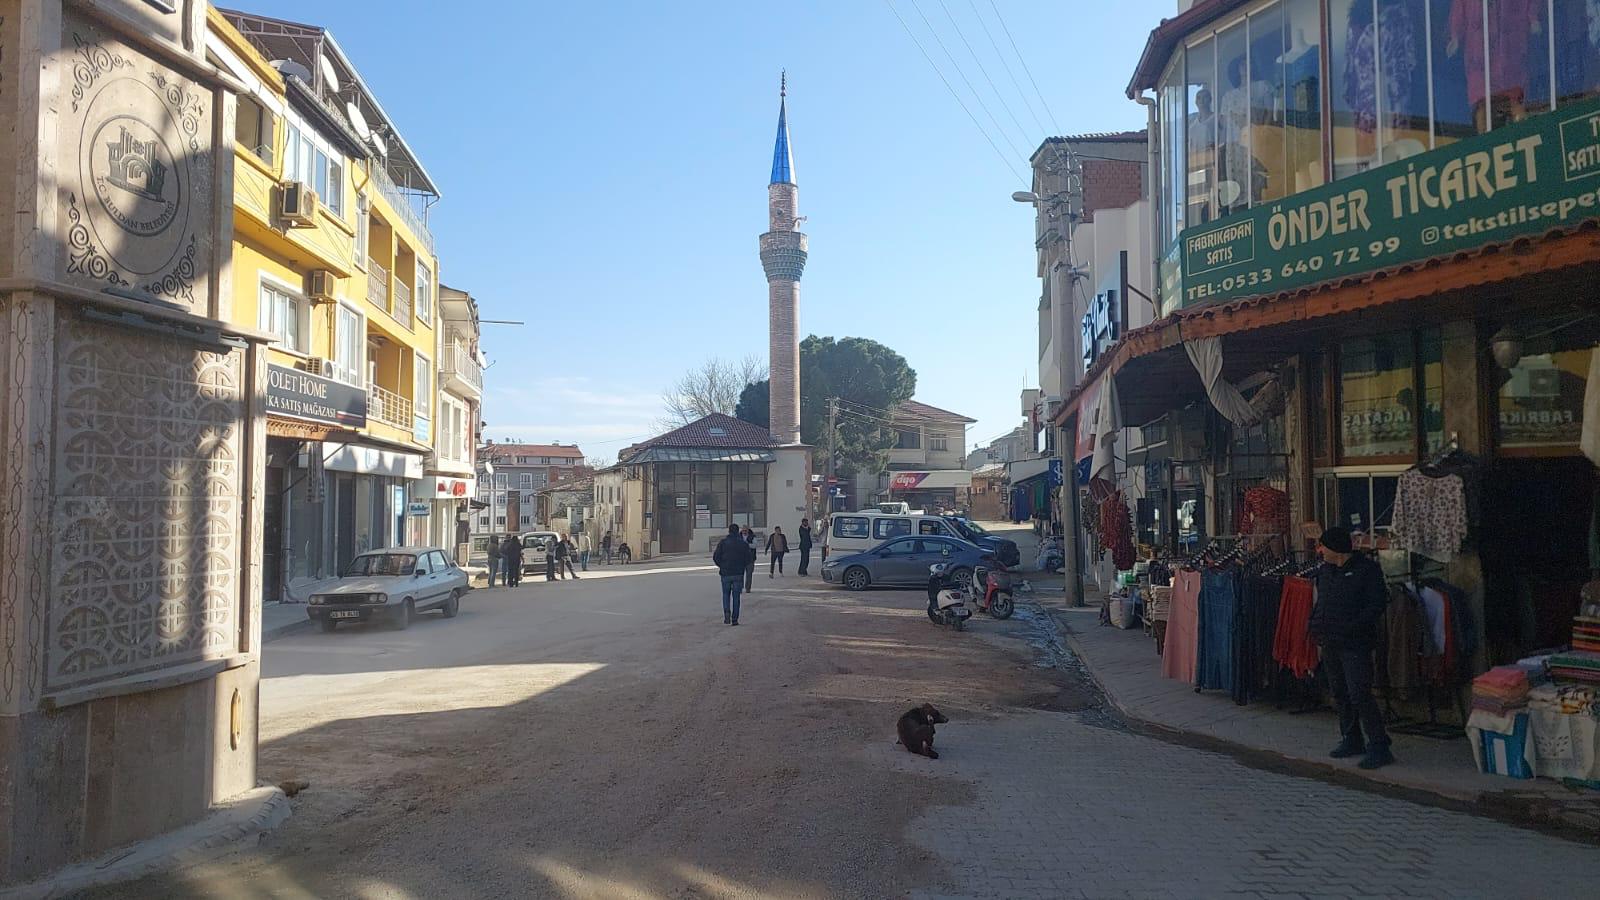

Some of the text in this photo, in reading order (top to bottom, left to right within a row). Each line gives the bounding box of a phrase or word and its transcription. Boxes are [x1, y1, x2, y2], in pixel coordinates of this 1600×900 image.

[1589, 116, 1600, 137] T
[1268, 134, 1542, 250] ÖNDER TİCARET
[104, 196, 138, 229] BULDAN
[1443, 186, 1600, 240] tekstilsepe
[1188, 224, 1253, 254] FABRIKADAN
[1187, 236, 1401, 300] TEL:0533 640 72 99
[1207, 246, 1233, 266] SATIŞ
[280, 397, 301, 415] SATIŞ
[303, 402, 336, 419] MAĞAZASI
[897, 474, 916, 487] dyo
